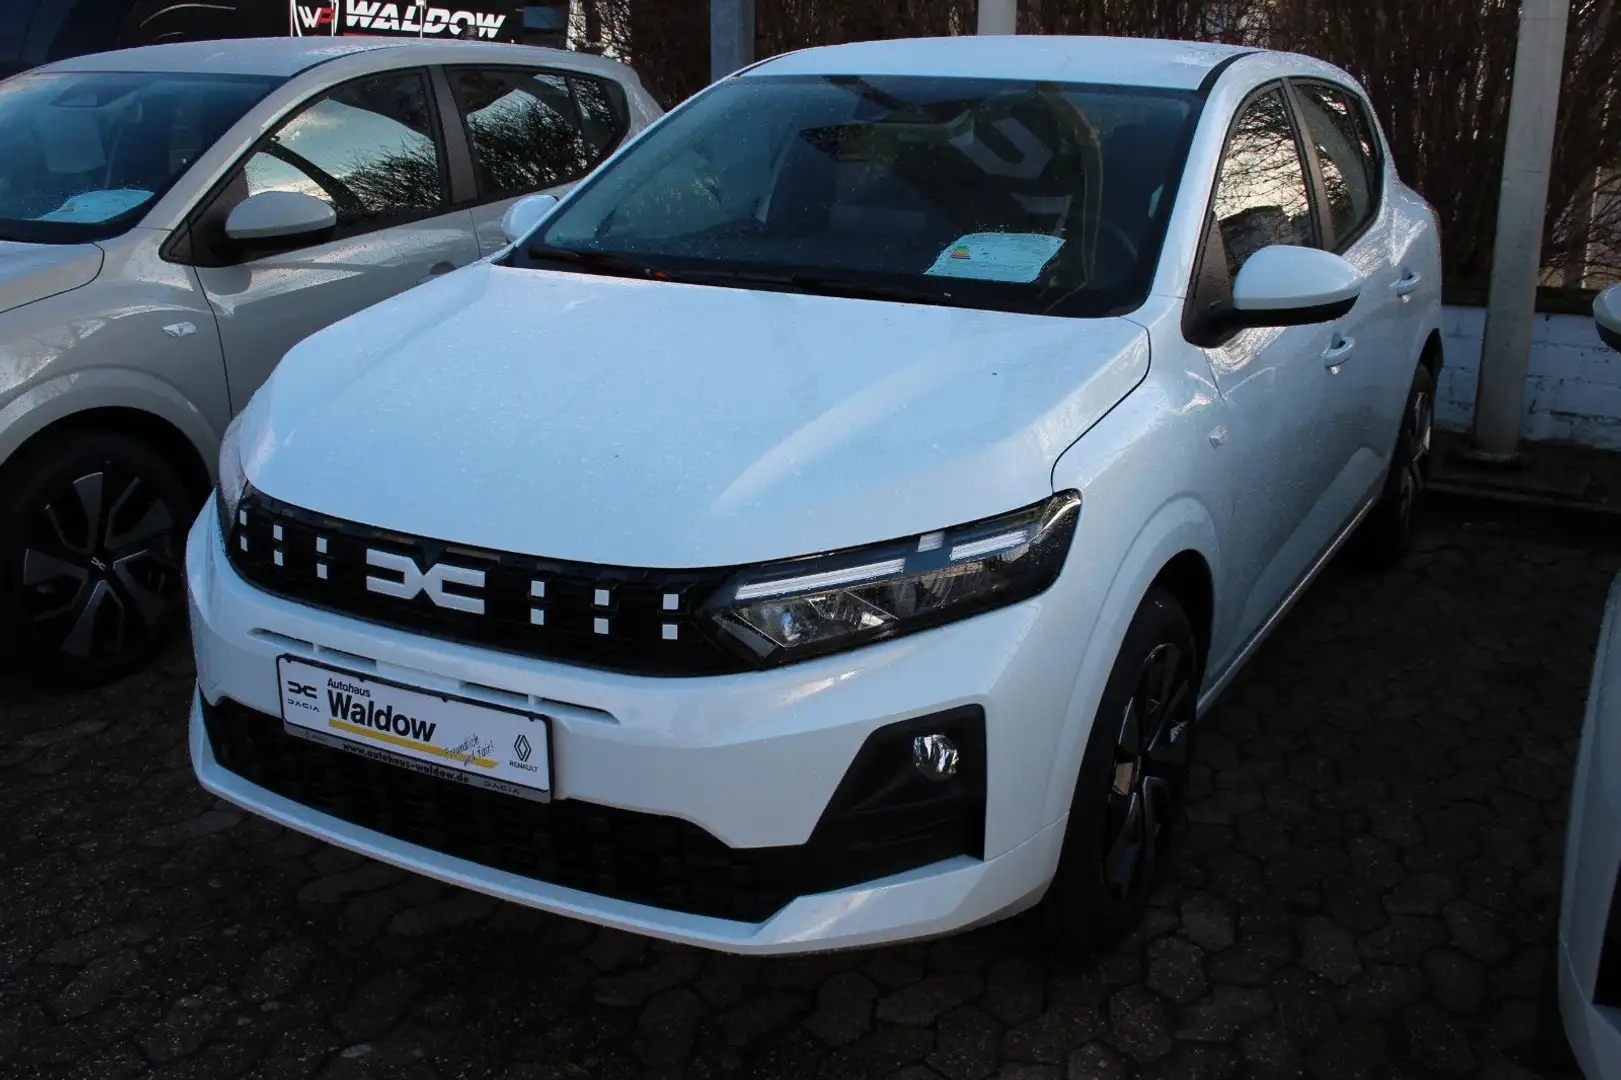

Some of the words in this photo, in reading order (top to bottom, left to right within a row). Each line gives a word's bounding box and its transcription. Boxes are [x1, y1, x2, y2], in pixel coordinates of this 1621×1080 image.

[345, 0, 506, 39] WALDOW
[327, 677, 371, 698] Autohaus
[288, 698, 320, 713] DACIA
[327, 689, 436, 742] Waldow
[342, 742, 470, 783] www.autohaus-waldow.de
[509, 760, 539, 773] RENAULT
[483, 780, 520, 795] DACIA
